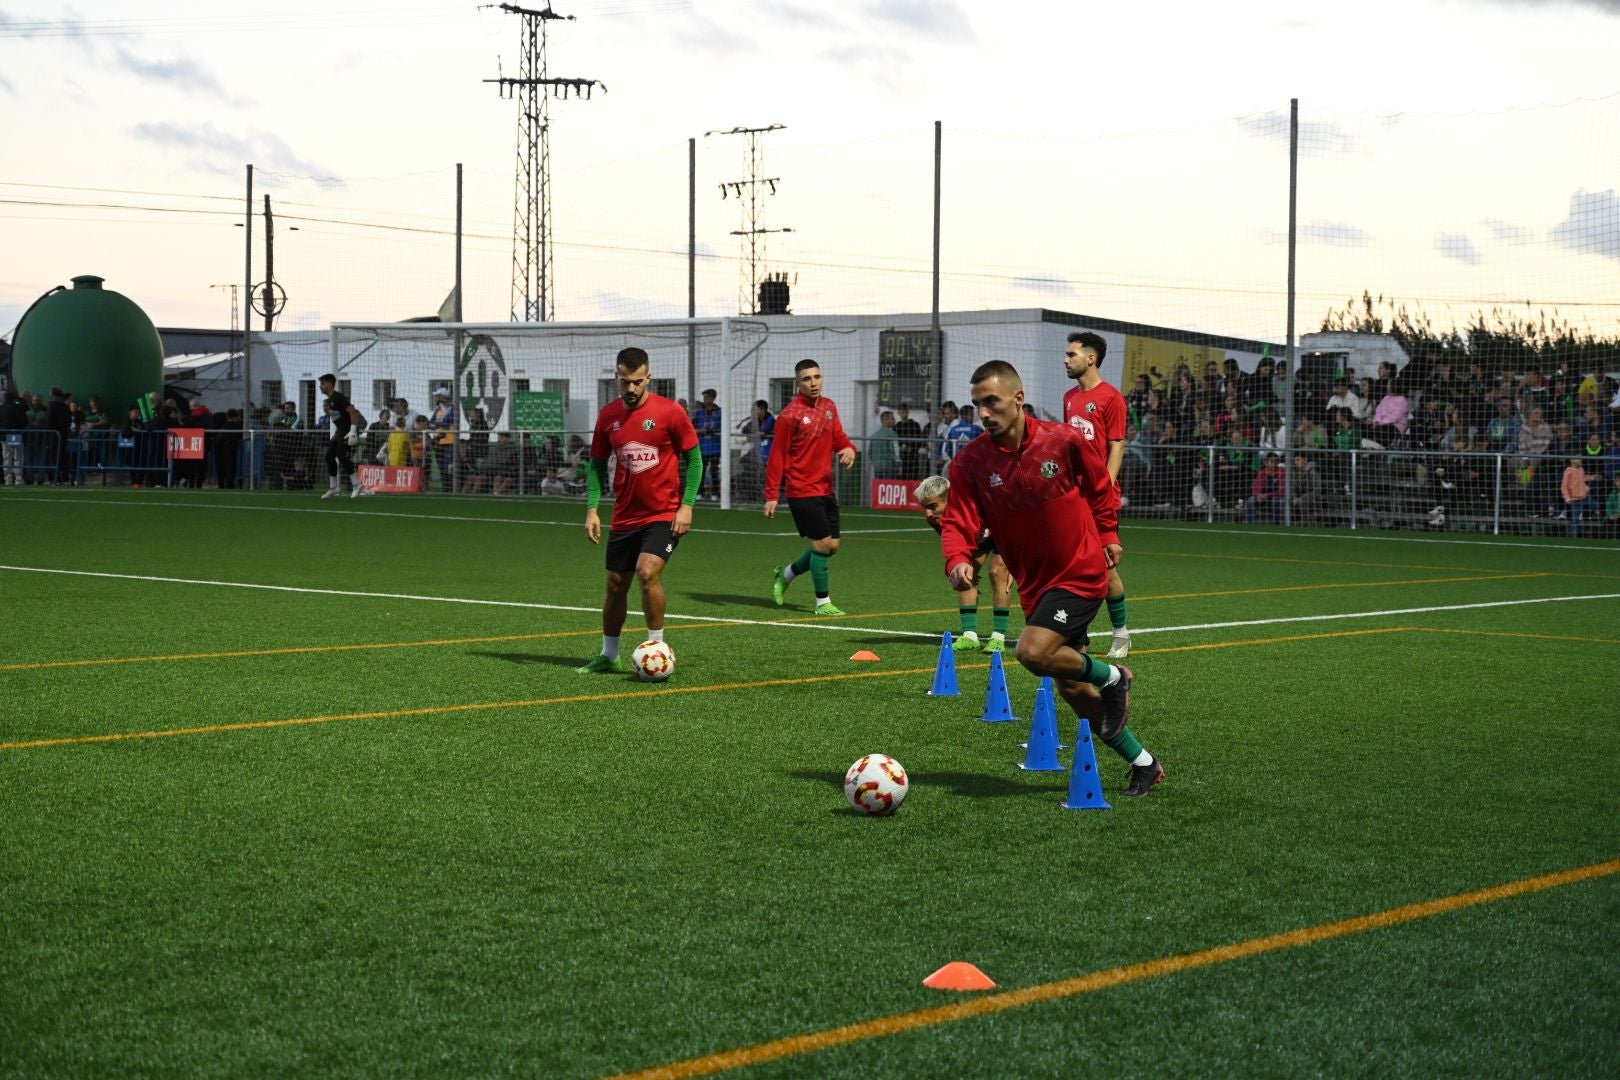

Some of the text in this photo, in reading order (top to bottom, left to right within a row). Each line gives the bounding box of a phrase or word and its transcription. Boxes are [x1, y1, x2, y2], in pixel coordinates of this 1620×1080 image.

[881, 364, 895, 377] LOC
[361, 467, 414, 489] COPA REY
[878, 483, 908, 506] COPA
